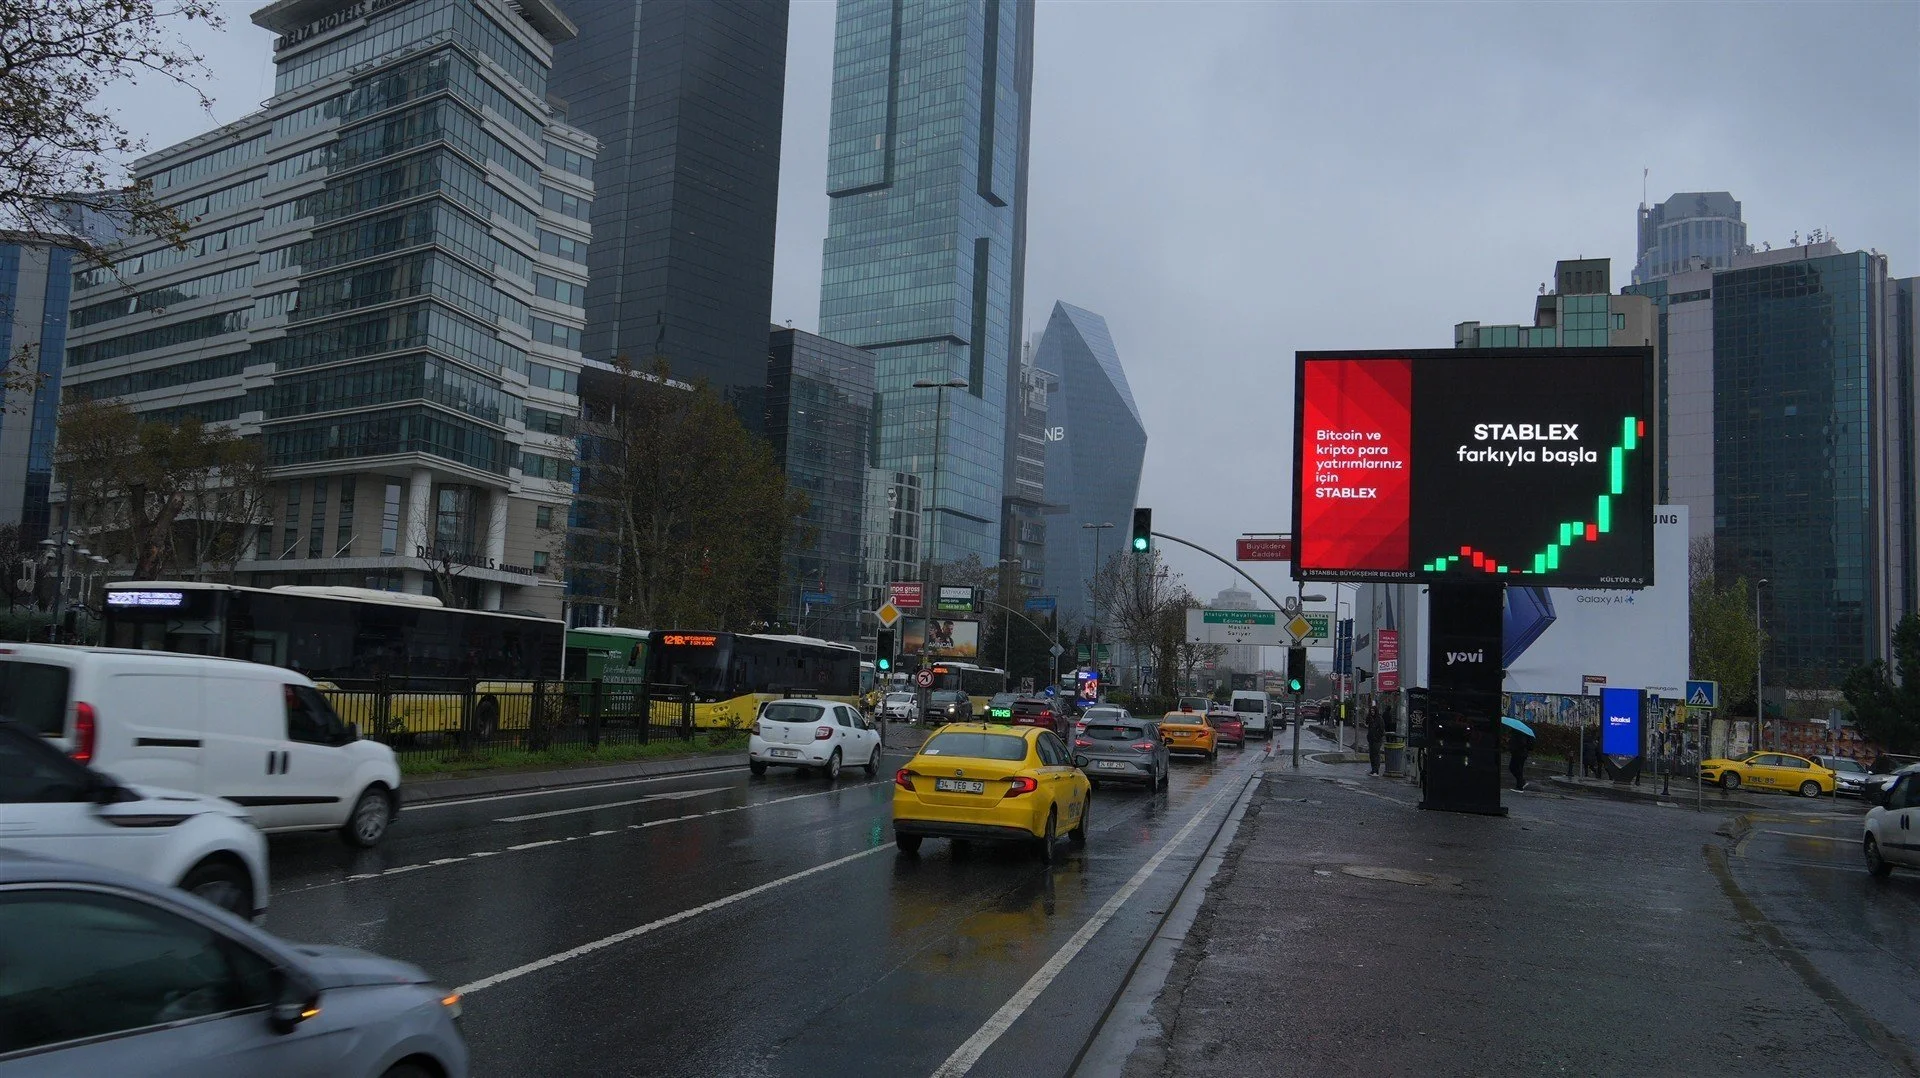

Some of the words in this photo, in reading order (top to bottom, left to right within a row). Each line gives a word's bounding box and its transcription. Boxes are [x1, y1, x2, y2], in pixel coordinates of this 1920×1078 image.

[279, 23, 313, 48] DELTA
[318, 2, 366, 33] HOTELS
[1316, 430, 1362, 440] Bitcoin
[1366, 432, 1381, 440] ve
[1474, 424, 1579, 440] STABLEX
[1316, 444, 1354, 457] kripto
[1358, 447, 1388, 457] para
[1457, 446, 1535, 466] farkıyla
[1542, 447, 1597, 466] başla
[1316, 459, 1402, 470] yatırımlarınız
[1316, 472, 1338, 484] için
[1316, 488, 1376, 498] STABLEX
[499, 564, 532, 576] MARRIOTT
[1577, 595, 1611, 605] Galaxy
[1446, 649, 1483, 665] yovi
[973, 783, 982, 791] 52
